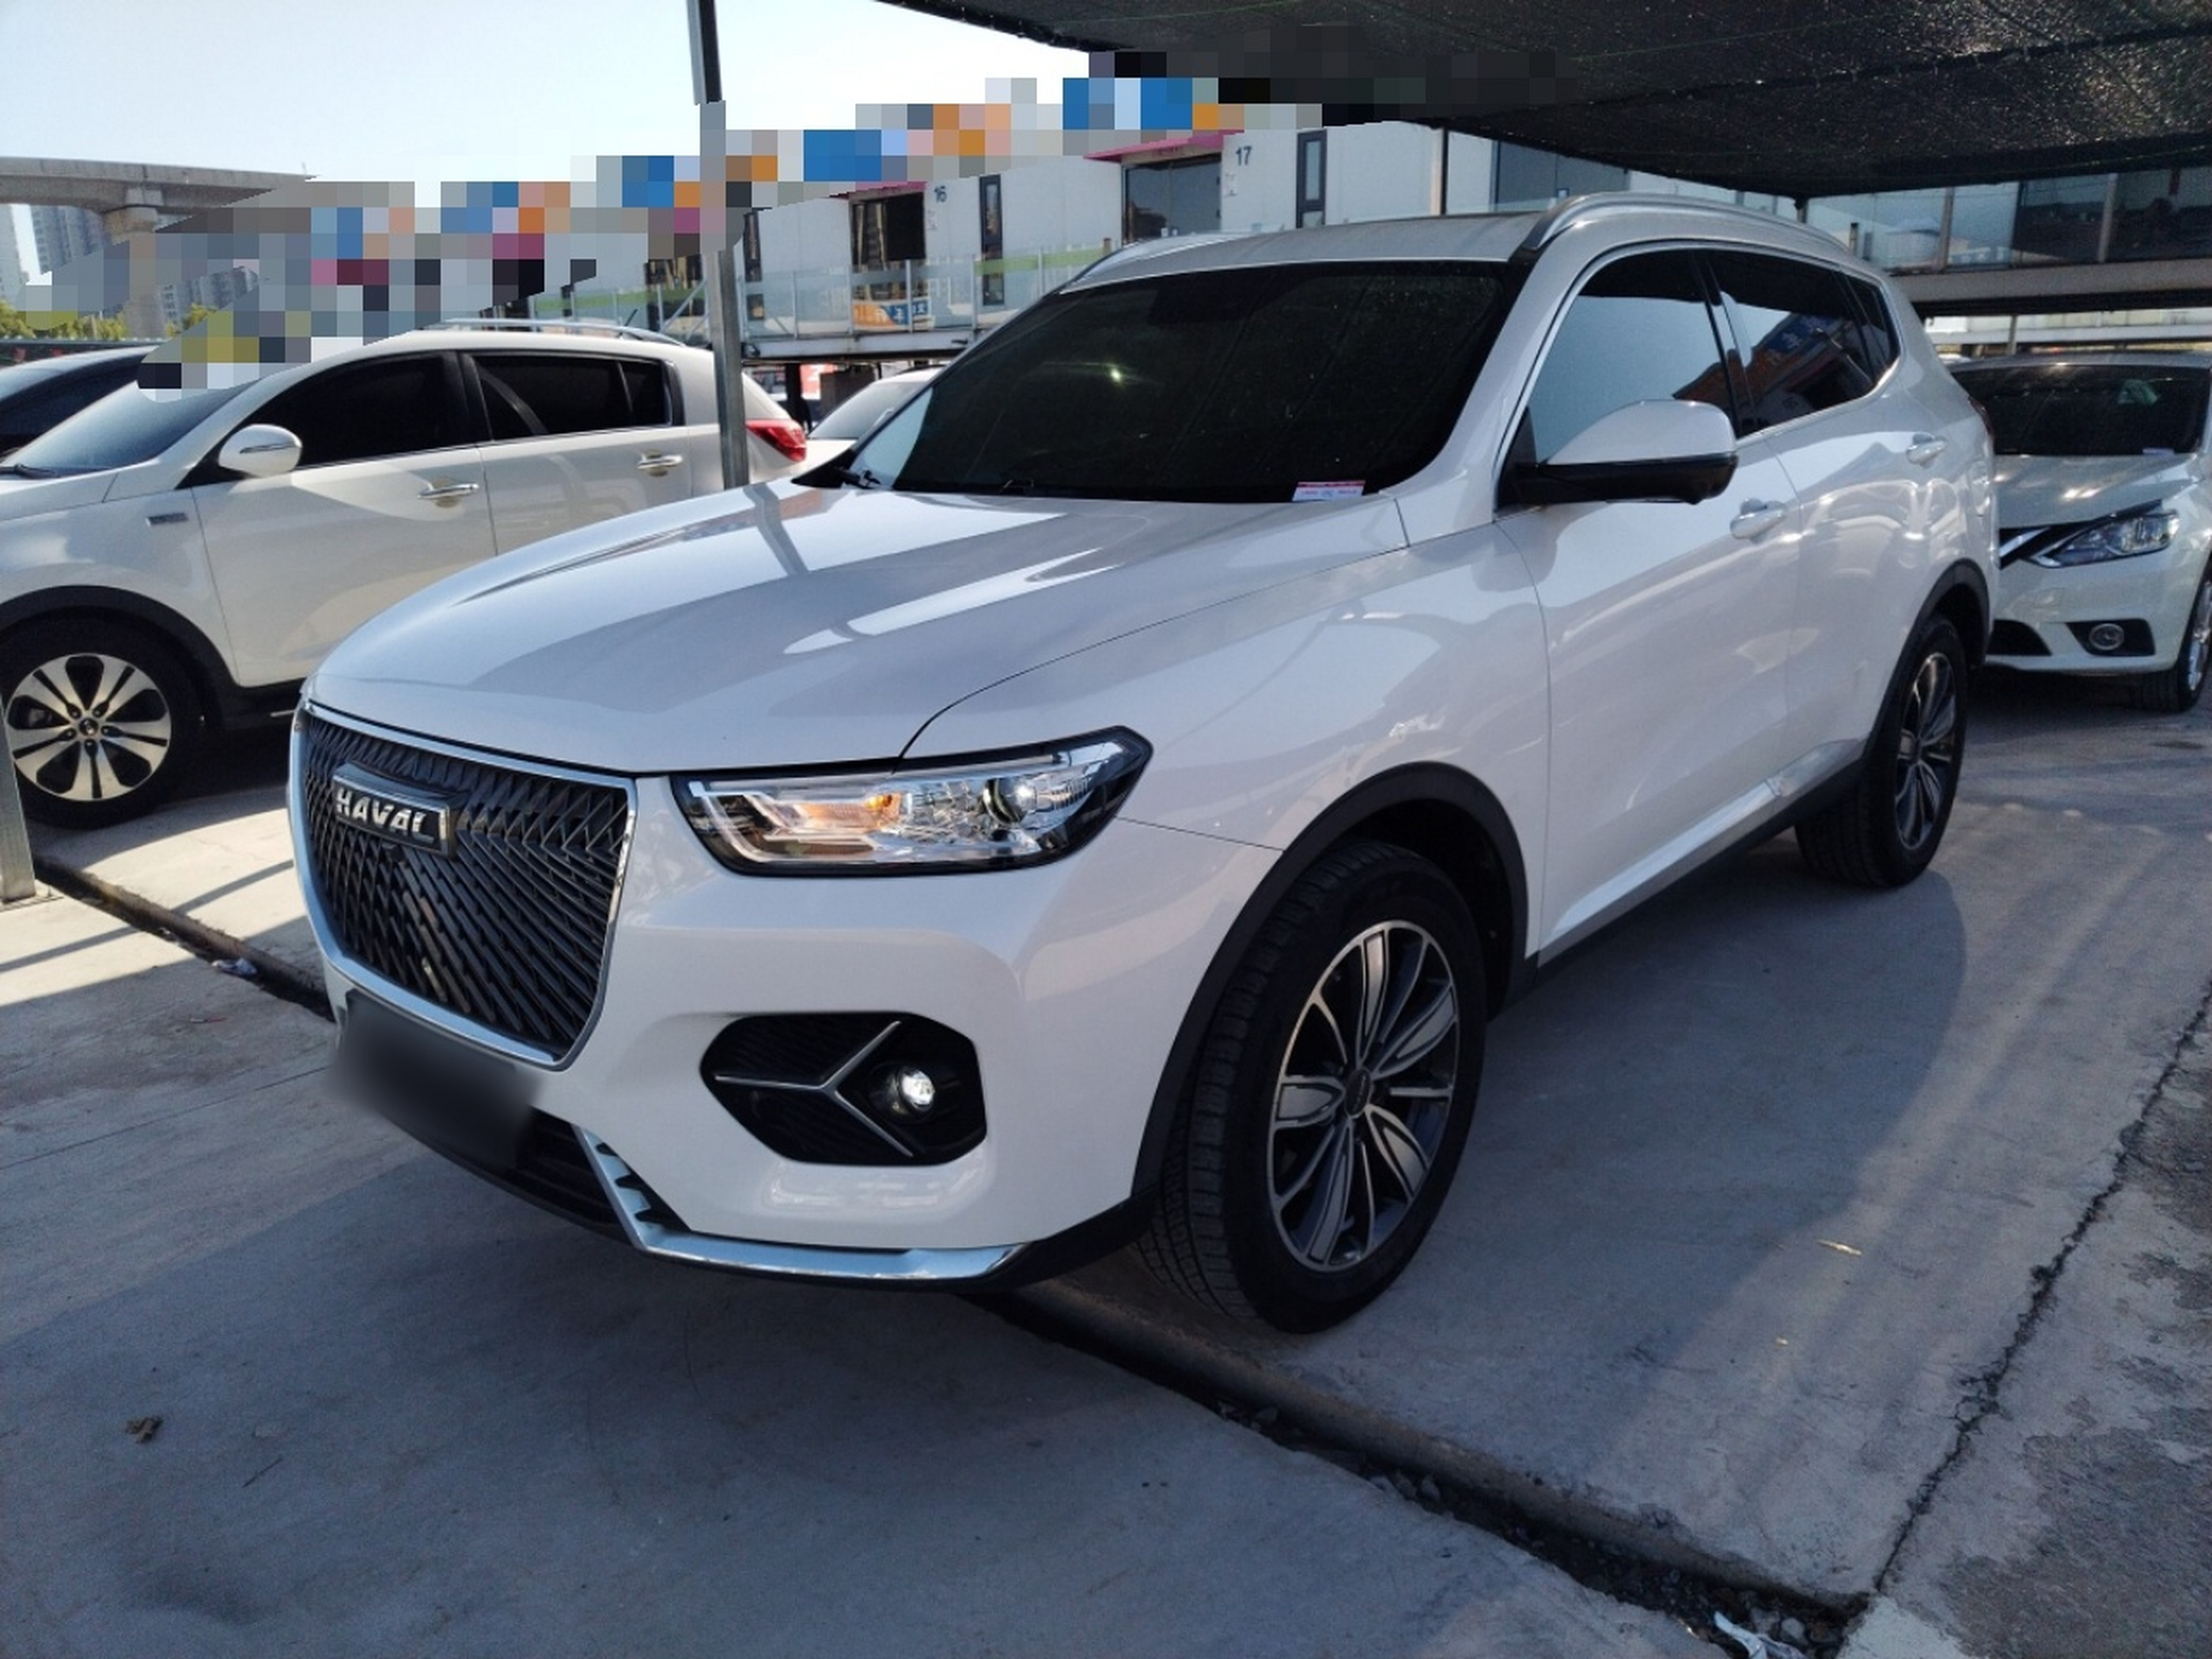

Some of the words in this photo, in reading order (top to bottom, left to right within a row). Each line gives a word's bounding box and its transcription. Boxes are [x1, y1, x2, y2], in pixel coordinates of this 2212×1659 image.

[1236, 146, 1252, 166] 17
[934, 185, 948, 203] 16
[336, 787, 435, 844] HAVAL
